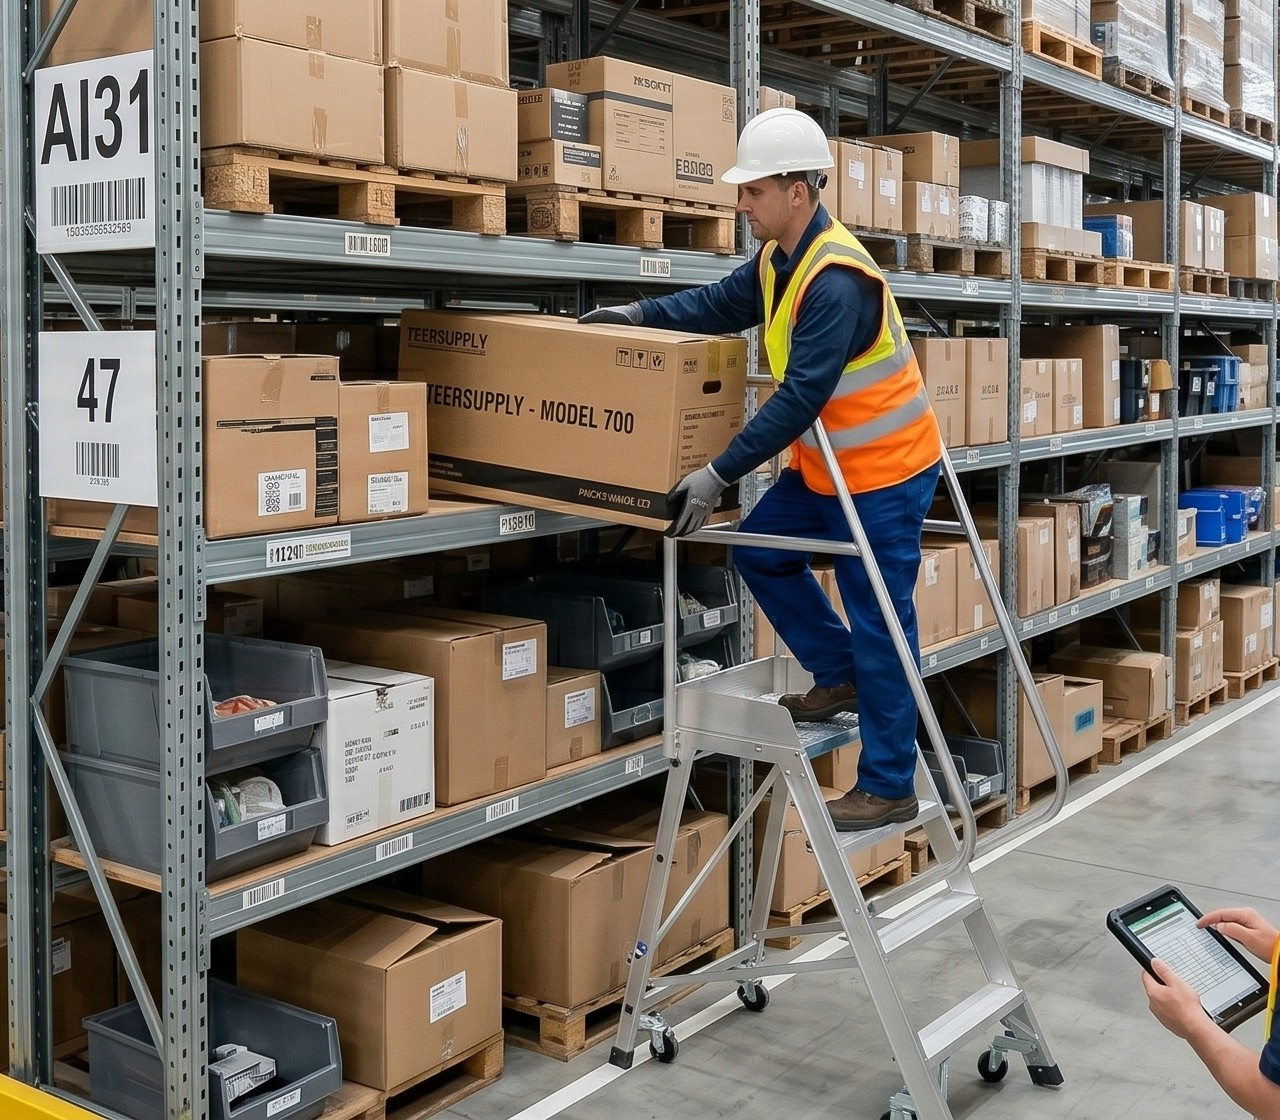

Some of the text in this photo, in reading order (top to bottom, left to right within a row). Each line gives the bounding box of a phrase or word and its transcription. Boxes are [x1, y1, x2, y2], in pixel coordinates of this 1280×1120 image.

[407, 326, 488, 349] TEERSUPPLY
[76, 357, 121, 424] 47
[426, 383, 524, 417] TEERSUPPLY
[540, 399, 598, 429] MODEL
[603, 408, 635, 435] 700
